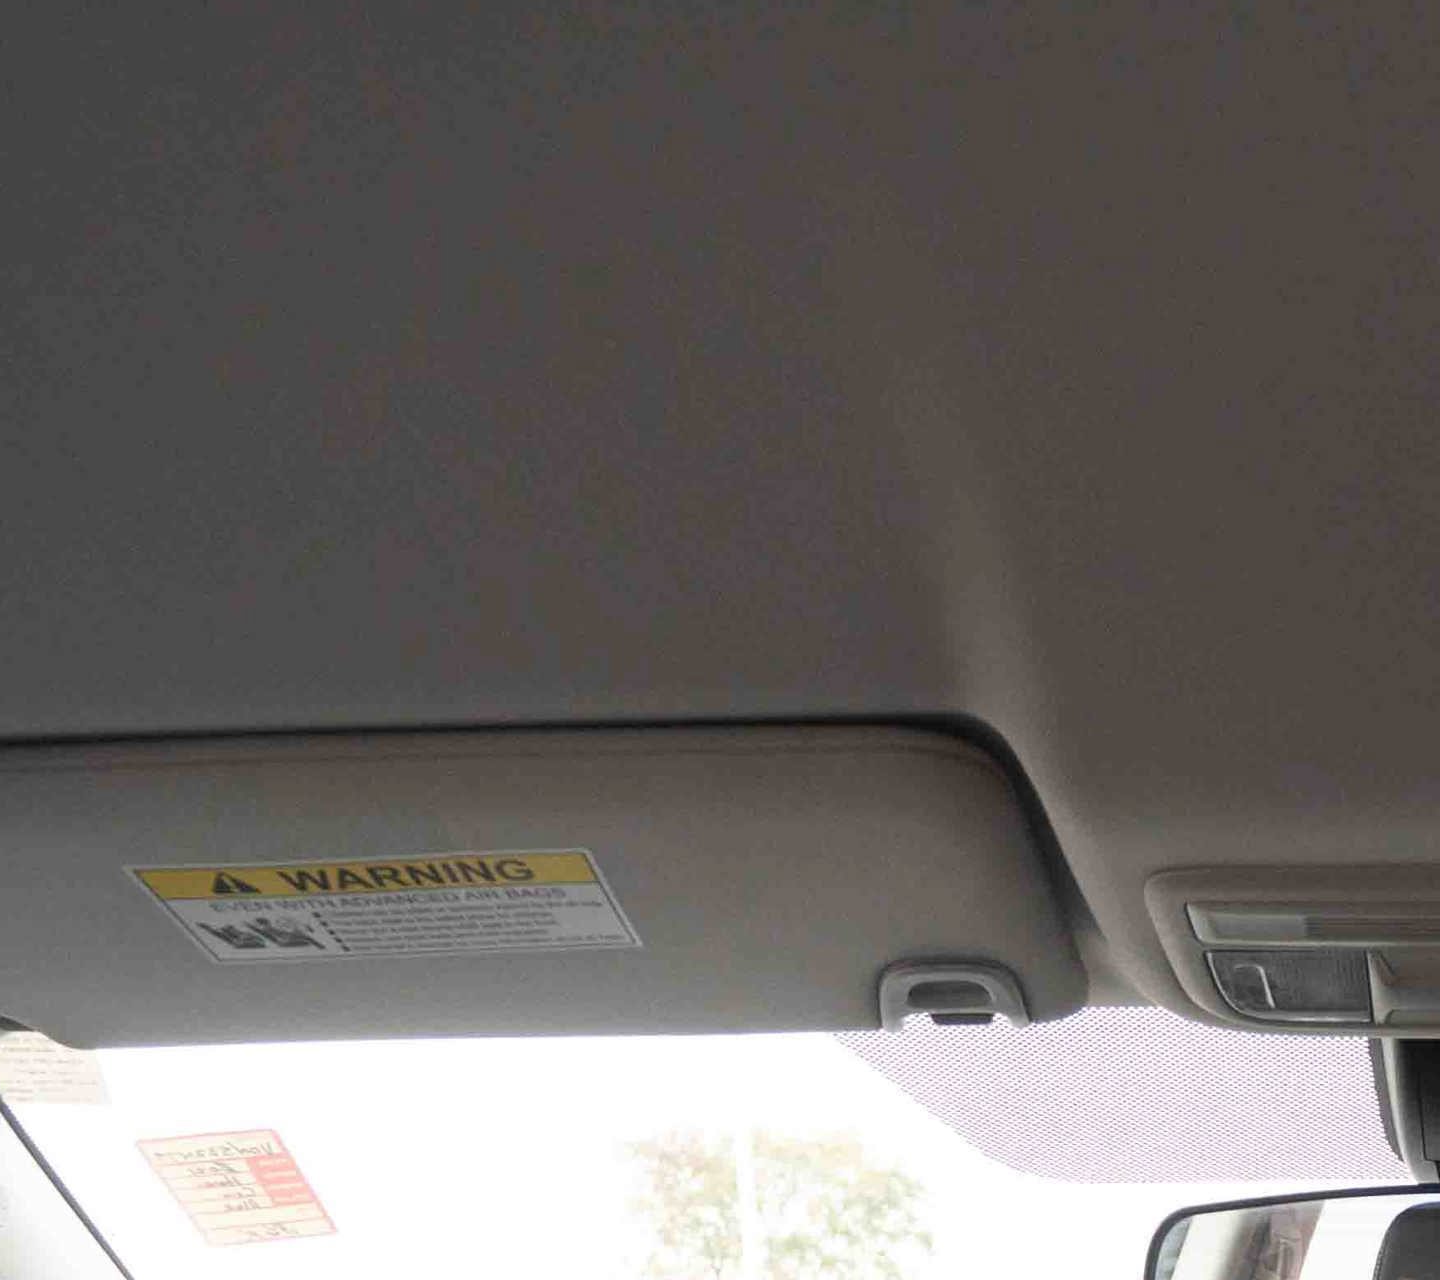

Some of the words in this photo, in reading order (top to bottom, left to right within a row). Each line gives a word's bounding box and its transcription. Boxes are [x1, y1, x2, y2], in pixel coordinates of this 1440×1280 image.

[277, 858, 537, 892] WARNING
[335, 891, 464, 909] ADVANCED
[506, 886, 567, 900] BAGS
